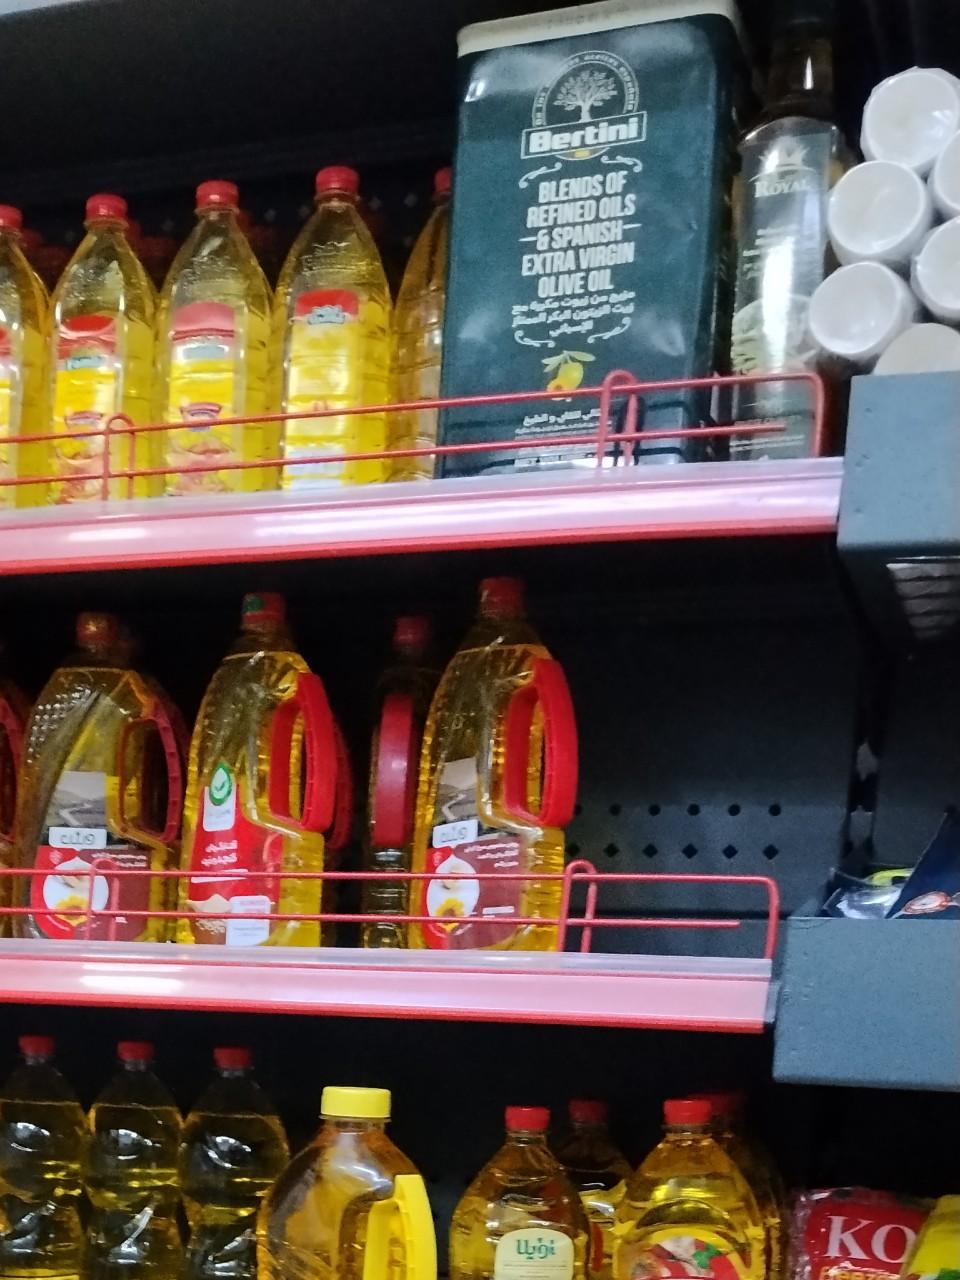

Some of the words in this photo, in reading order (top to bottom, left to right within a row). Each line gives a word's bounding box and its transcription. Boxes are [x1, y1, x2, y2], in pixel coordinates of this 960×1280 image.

[529, 117, 638, 153] Bertini
[538, 174, 604, 203] BLENDS
[605, 170, 628, 194] OF
[526, 199, 596, 228] REFINED
[598, 194, 637, 219] OILS
[536, 229, 550, 250] &
[551, 219, 624, 249] SPANISH
[521, 250, 577, 276] EXTRA
[579, 241, 636, 270] VIRGIN
[538, 272, 587, 298] OLIVE
[587, 269, 615, 292] OIL
